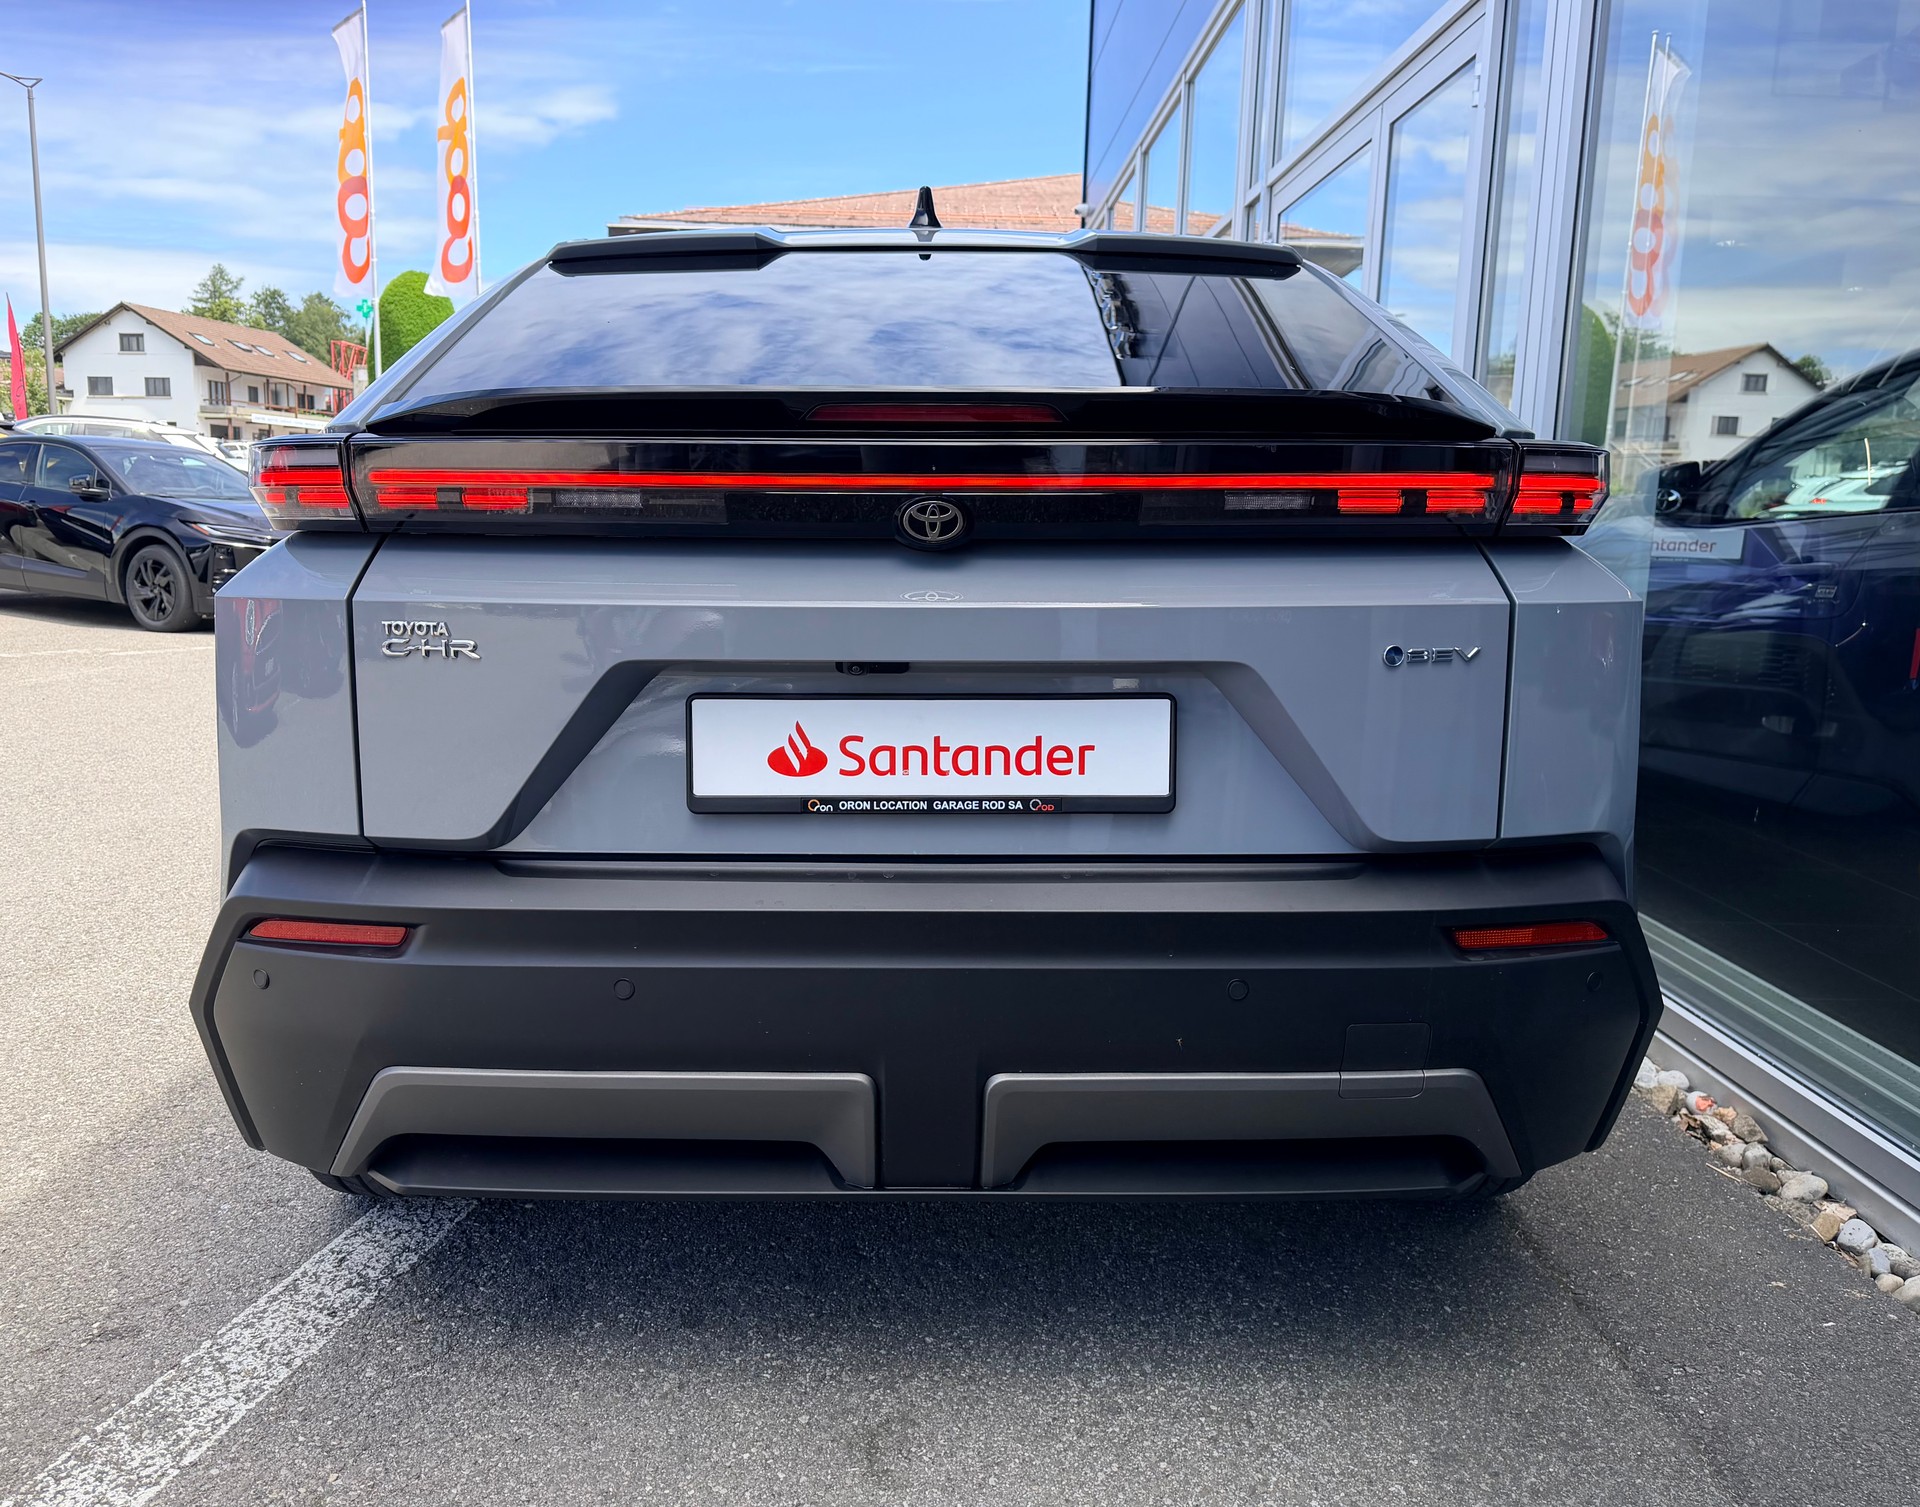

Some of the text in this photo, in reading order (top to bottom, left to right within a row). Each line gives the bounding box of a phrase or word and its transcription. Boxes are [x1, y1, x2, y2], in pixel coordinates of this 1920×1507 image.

[1653, 538, 1717, 553] ntander
[381, 621, 450, 637] TOYOTA
[382, 638, 481, 660] C-HR
[1407, 646, 1481, 663] BEV
[838, 735, 1096, 777] Santander
[838, 800, 871, 810] ORON
[873, 800, 928, 810] LOCATION
[932, 800, 980, 810] GARAGE
[982, 800, 1006, 810] ROD
[1008, 800, 1024, 810] SA
